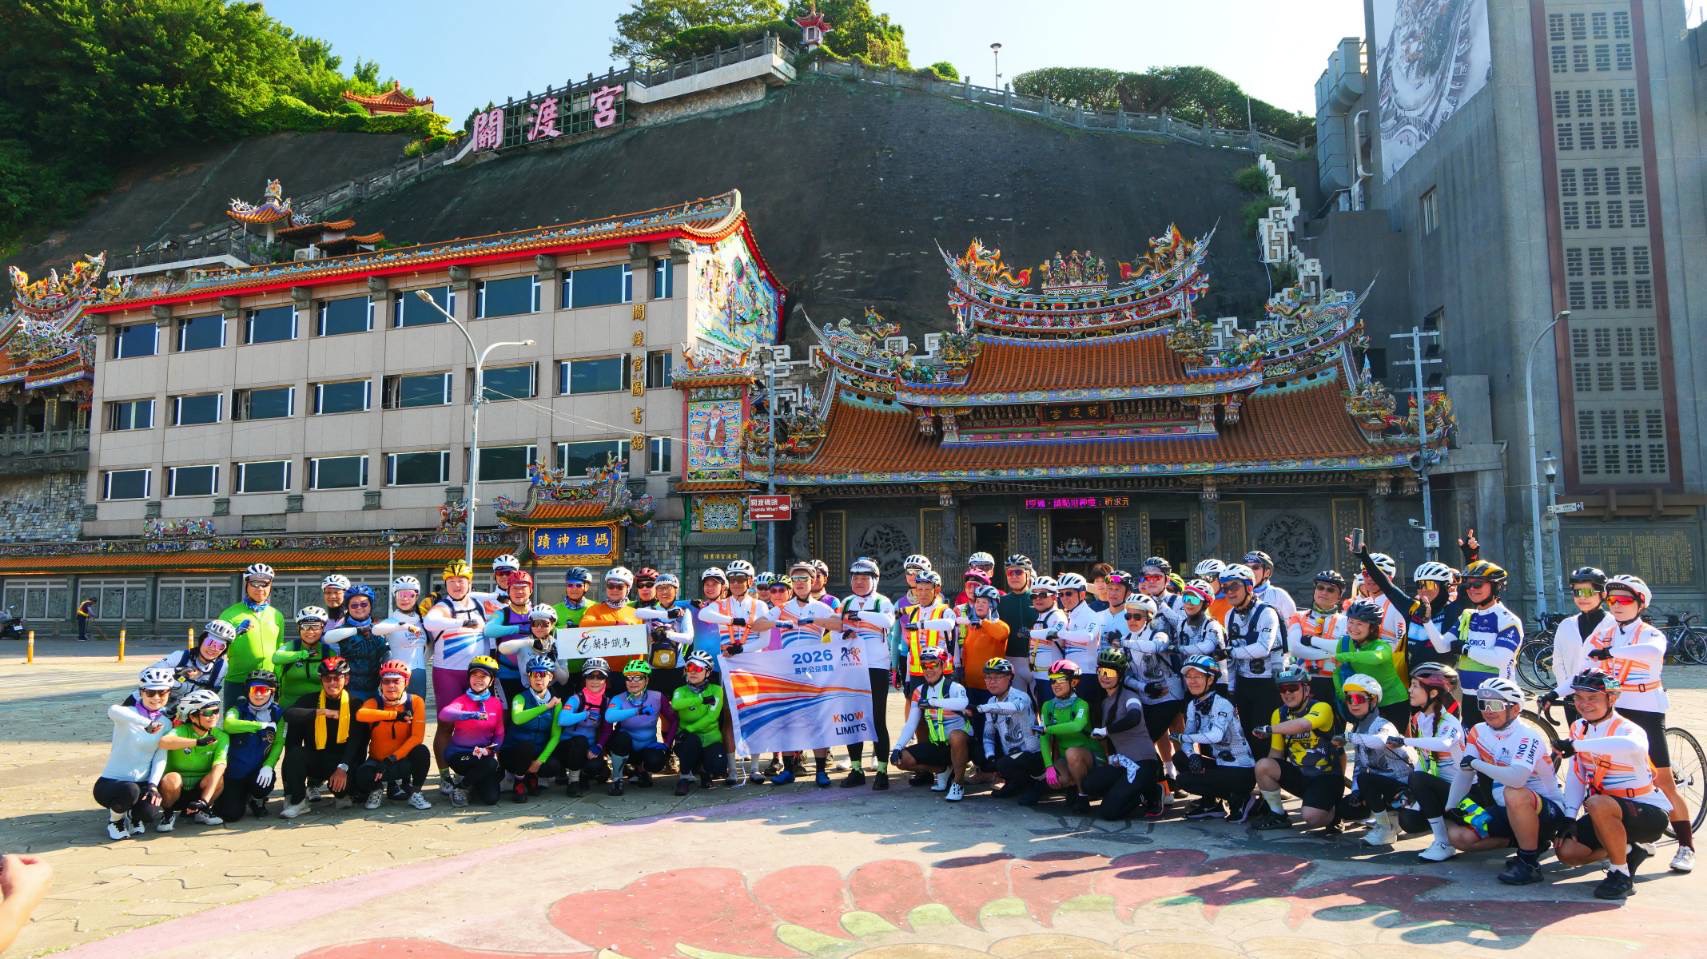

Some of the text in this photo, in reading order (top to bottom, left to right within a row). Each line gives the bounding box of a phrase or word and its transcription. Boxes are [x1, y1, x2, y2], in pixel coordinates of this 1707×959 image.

[473, 84, 625, 152] 關渡宮
[631, 303, 646, 451] 關渡宮圖書館
[791, 649, 833, 665] 2026
[832, 711, 864, 723] KNOW
[835, 723, 867, 736] LIMITS
[1514, 736, 1529, 760] KNOW
[1525, 738, 1540, 765] LIMITS
